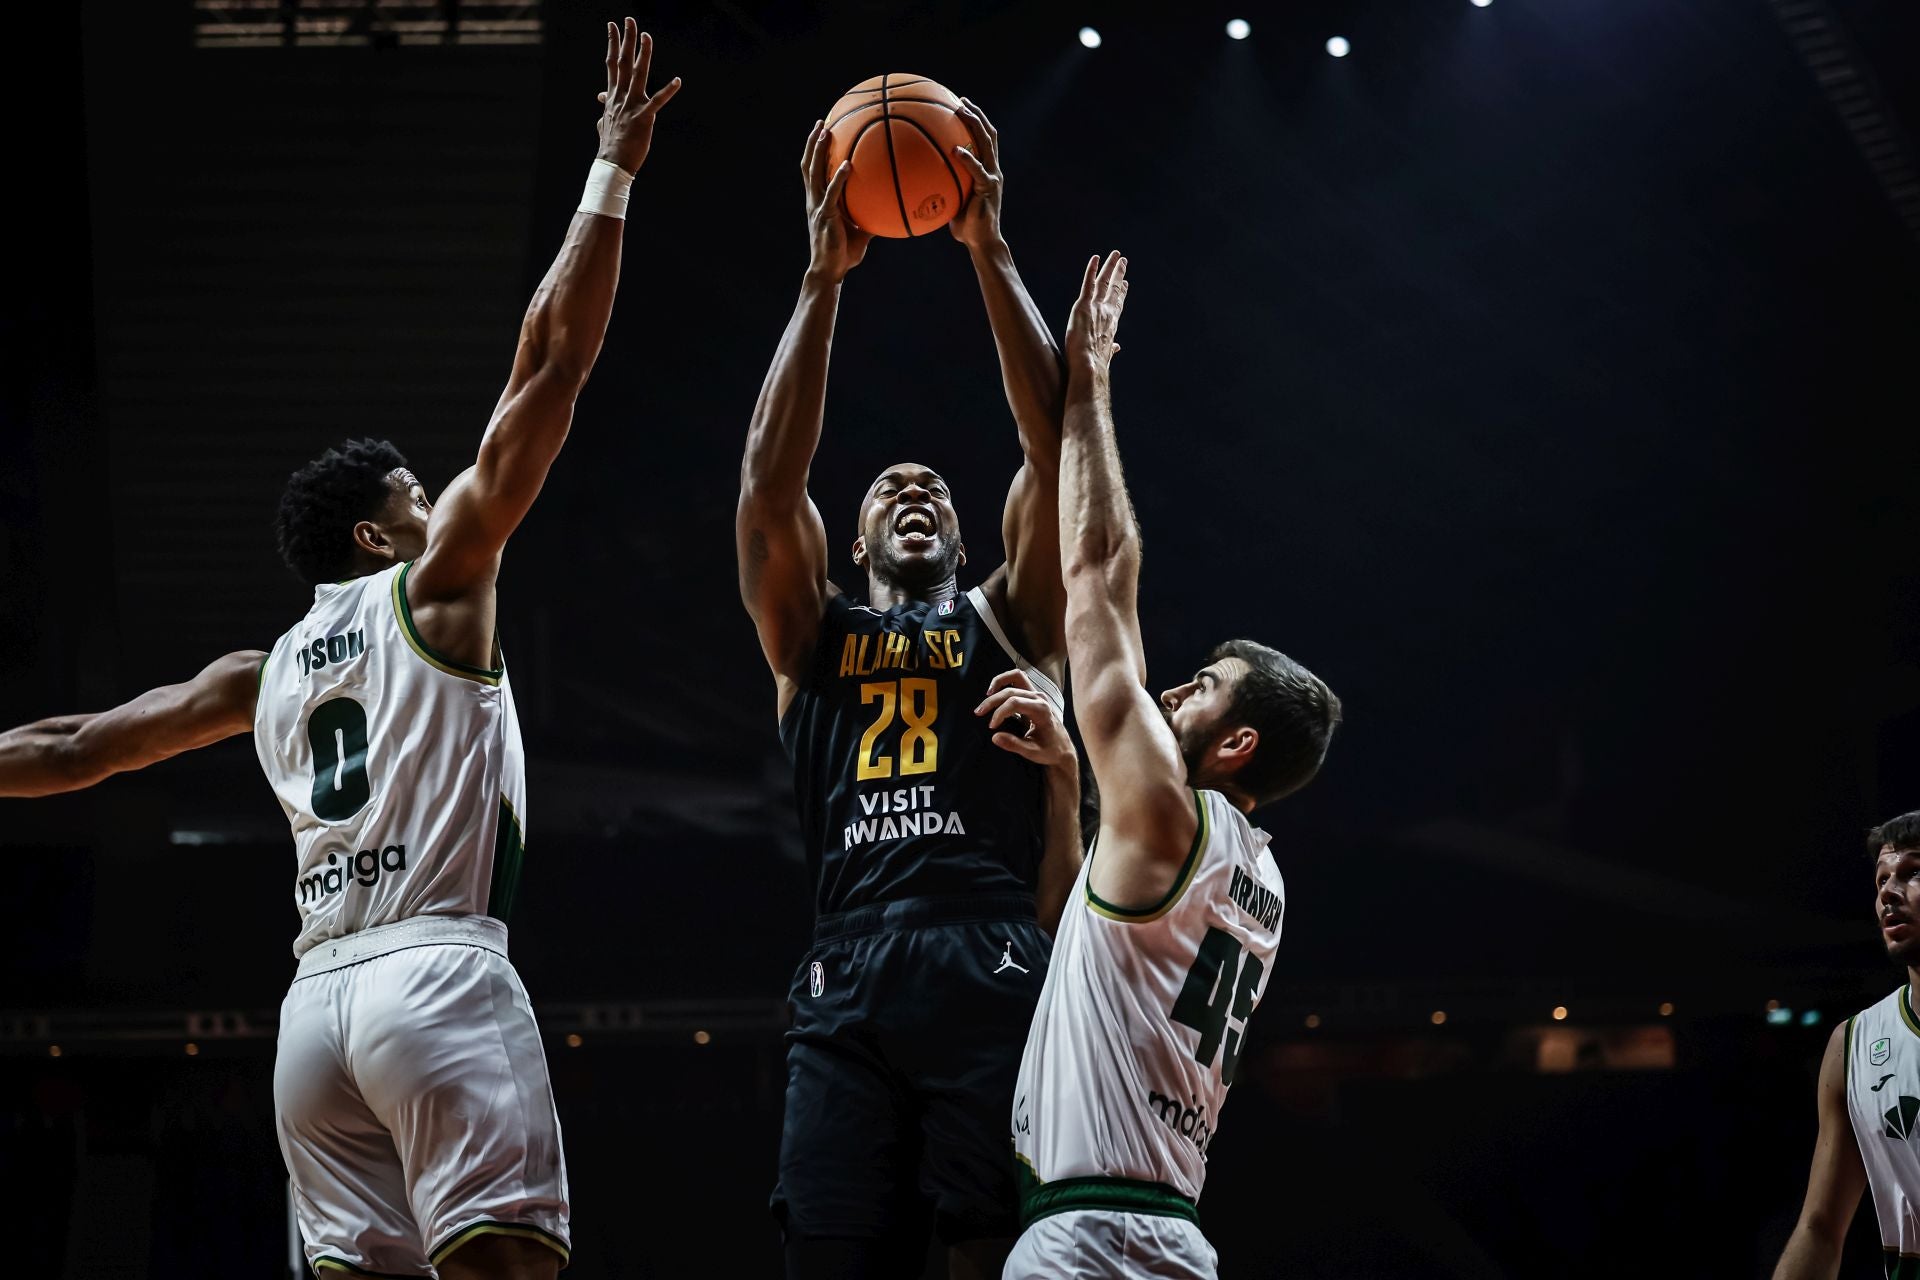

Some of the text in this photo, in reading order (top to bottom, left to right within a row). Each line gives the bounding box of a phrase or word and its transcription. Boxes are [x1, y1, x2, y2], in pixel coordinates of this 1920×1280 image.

[296, 627, 365, 684] YSON
[923, 629, 964, 670] SC
[307, 697, 371, 822] 0
[857, 677, 938, 782] 28
[844, 811, 966, 851] RWANDA
[858, 785, 935, 815] VISIT
[1228, 864, 1283, 935] KRAVISH
[1170, 926, 1264, 1087] 45
